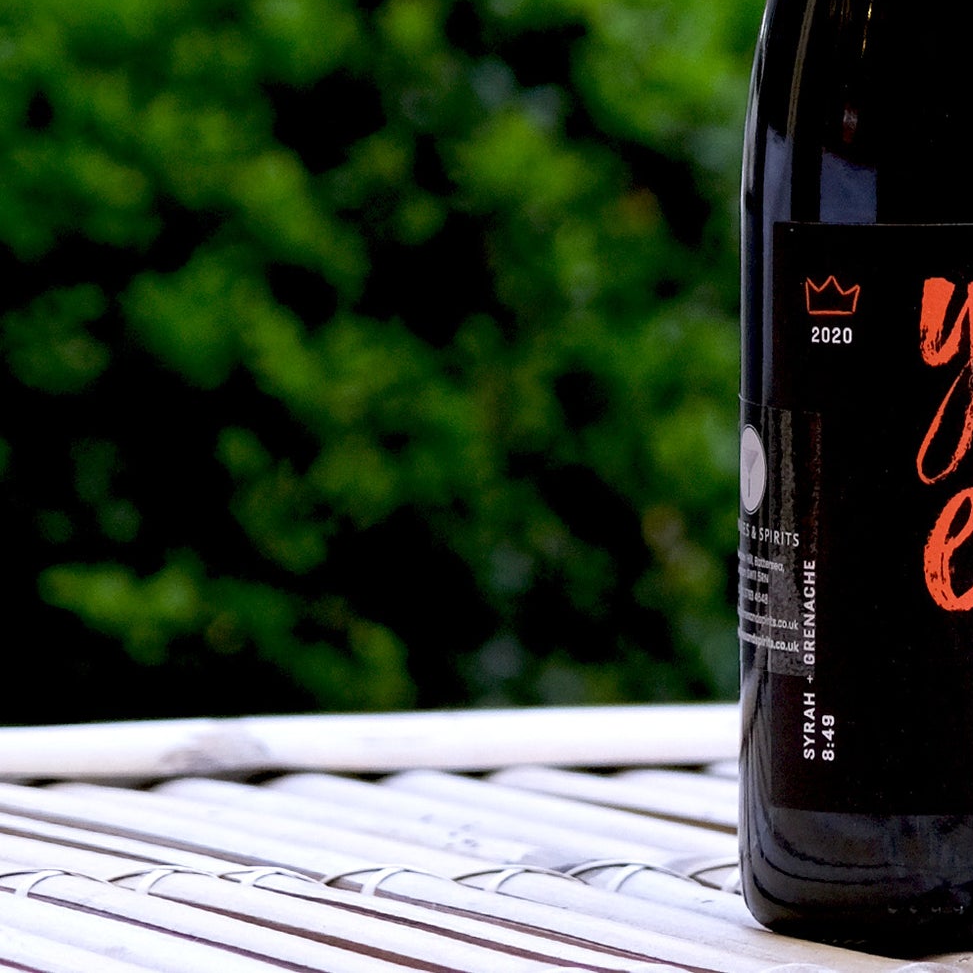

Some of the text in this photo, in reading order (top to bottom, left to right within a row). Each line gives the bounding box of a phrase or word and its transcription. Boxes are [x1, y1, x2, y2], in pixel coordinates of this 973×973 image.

[811, 326, 853, 344] 2020
[759, 526, 800, 547] SPIRITS
[803, 559, 816, 665] GRENACHE
[806, 674, 814, 684] +
[803, 692, 816, 760] SYRAH
[821, 714, 835, 761] 8:49
